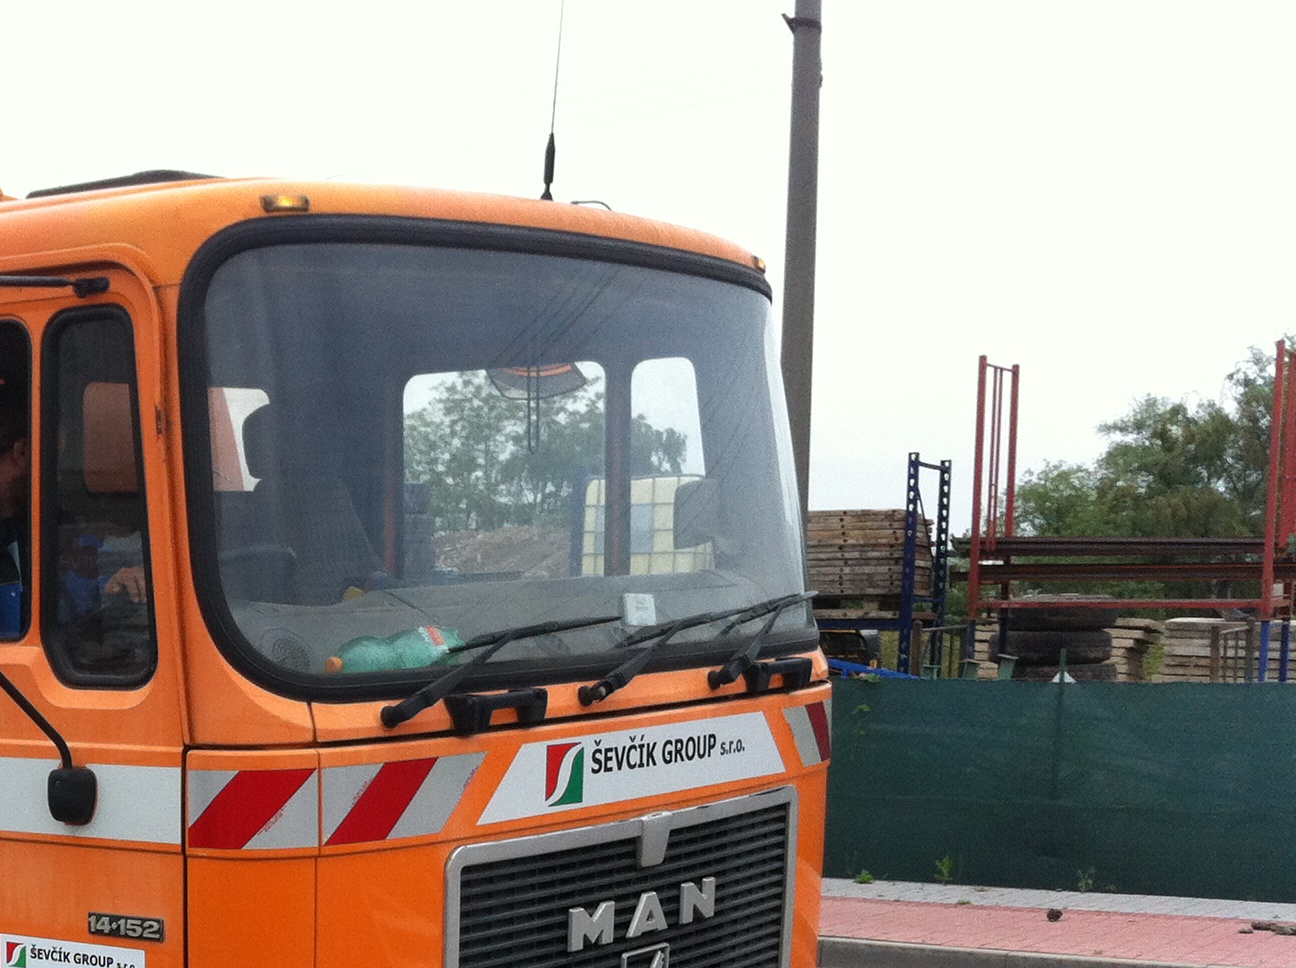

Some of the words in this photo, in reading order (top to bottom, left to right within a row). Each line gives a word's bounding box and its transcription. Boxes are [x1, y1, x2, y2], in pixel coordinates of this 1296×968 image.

[591, 734, 657, 775] ŠEVČÍK
[661, 733, 717, 765] GROUP
[720, 738, 746, 756] s.r.o.
[567, 876, 716, 952] MAN
[29, 944, 71, 964] ŠEVČÍK
[73, 951, 114, 968] GROUP
